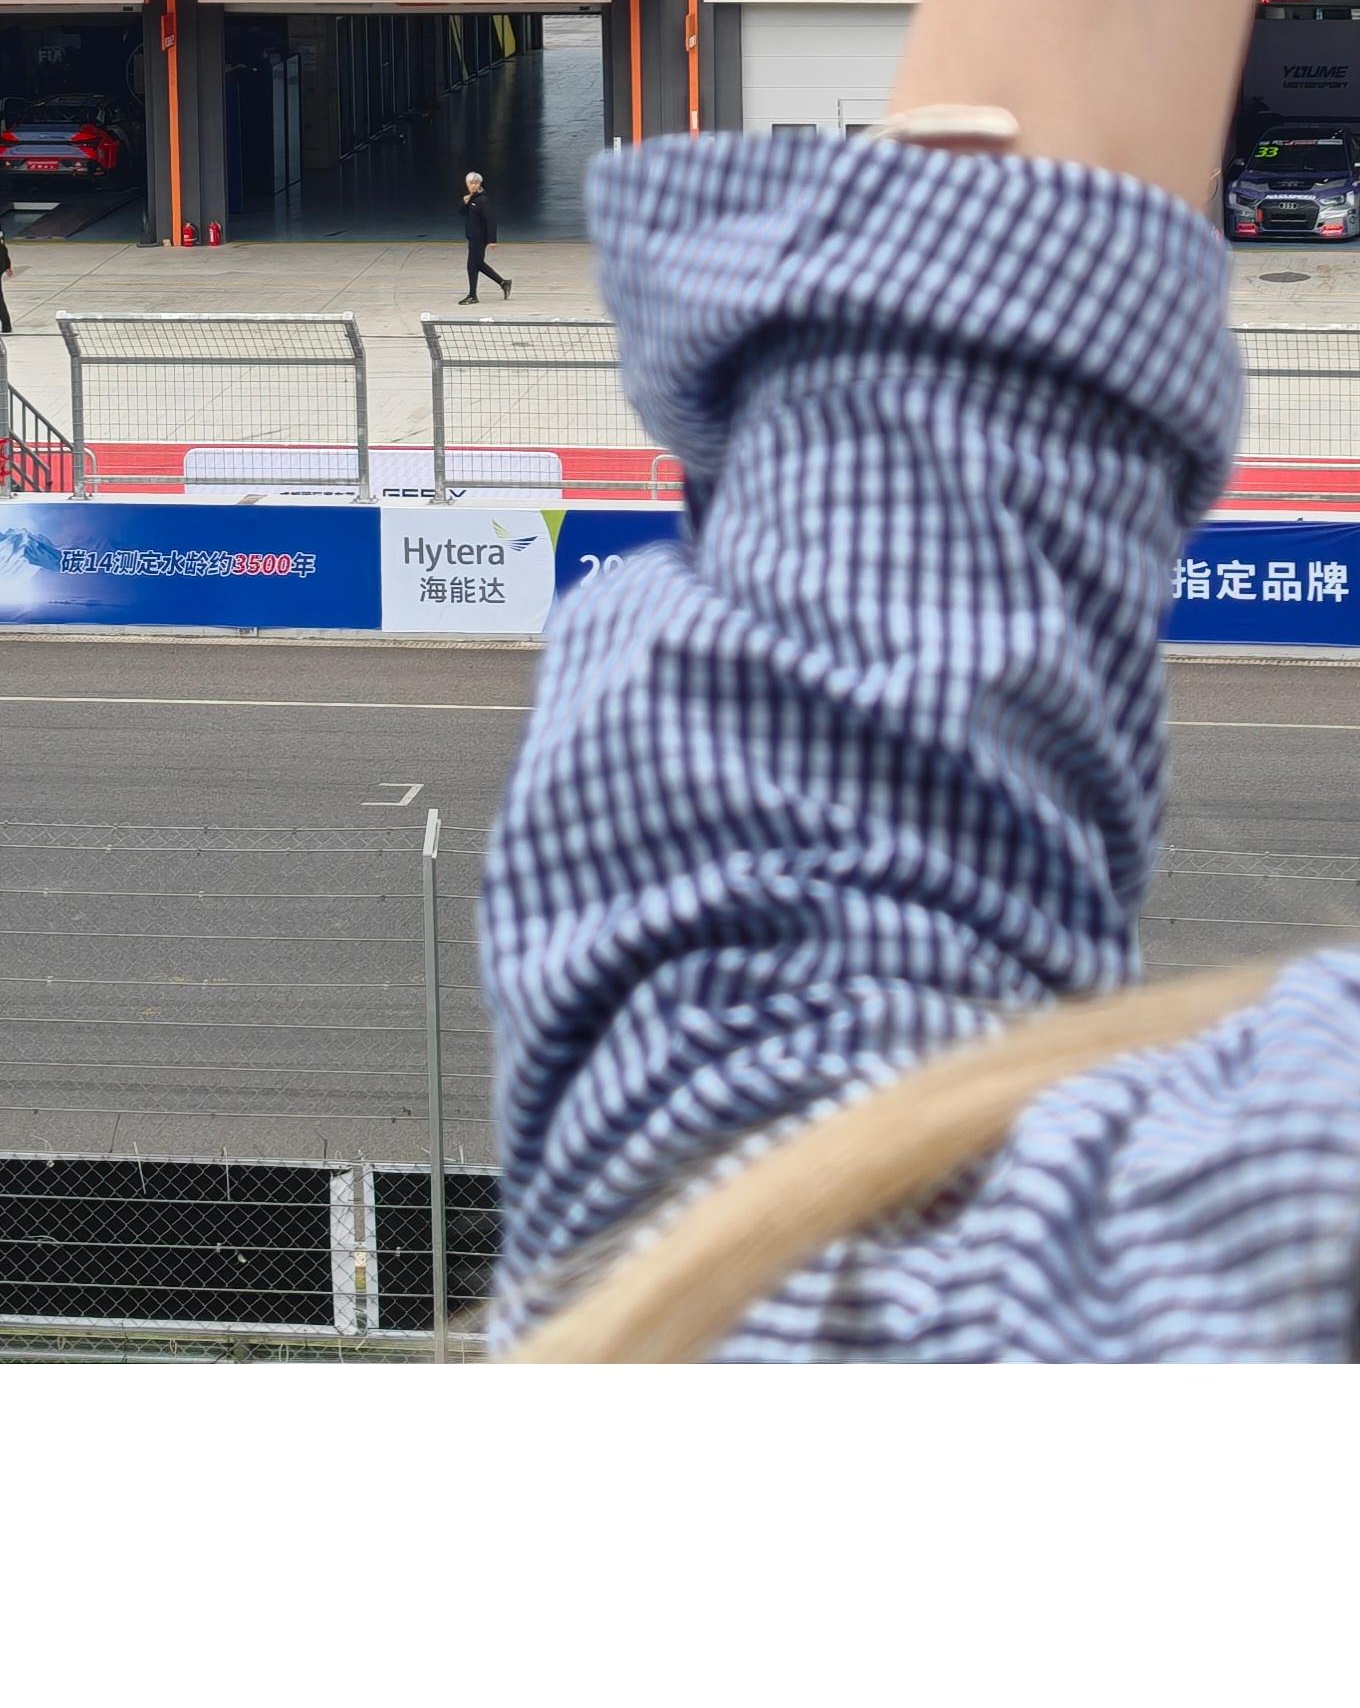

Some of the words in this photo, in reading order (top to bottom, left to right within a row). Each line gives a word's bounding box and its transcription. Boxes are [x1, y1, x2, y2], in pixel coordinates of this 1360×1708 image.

[1283, 65, 1349, 78] YOUME
[1255, 146, 1279, 158] 33
[59, 548, 317, 578] 碳14测定水龄约3500年
[404, 536, 505, 571] Hytera
[419, 575, 506, 605] 海能达
[1171, 558, 1350, 603] 指定品牌
